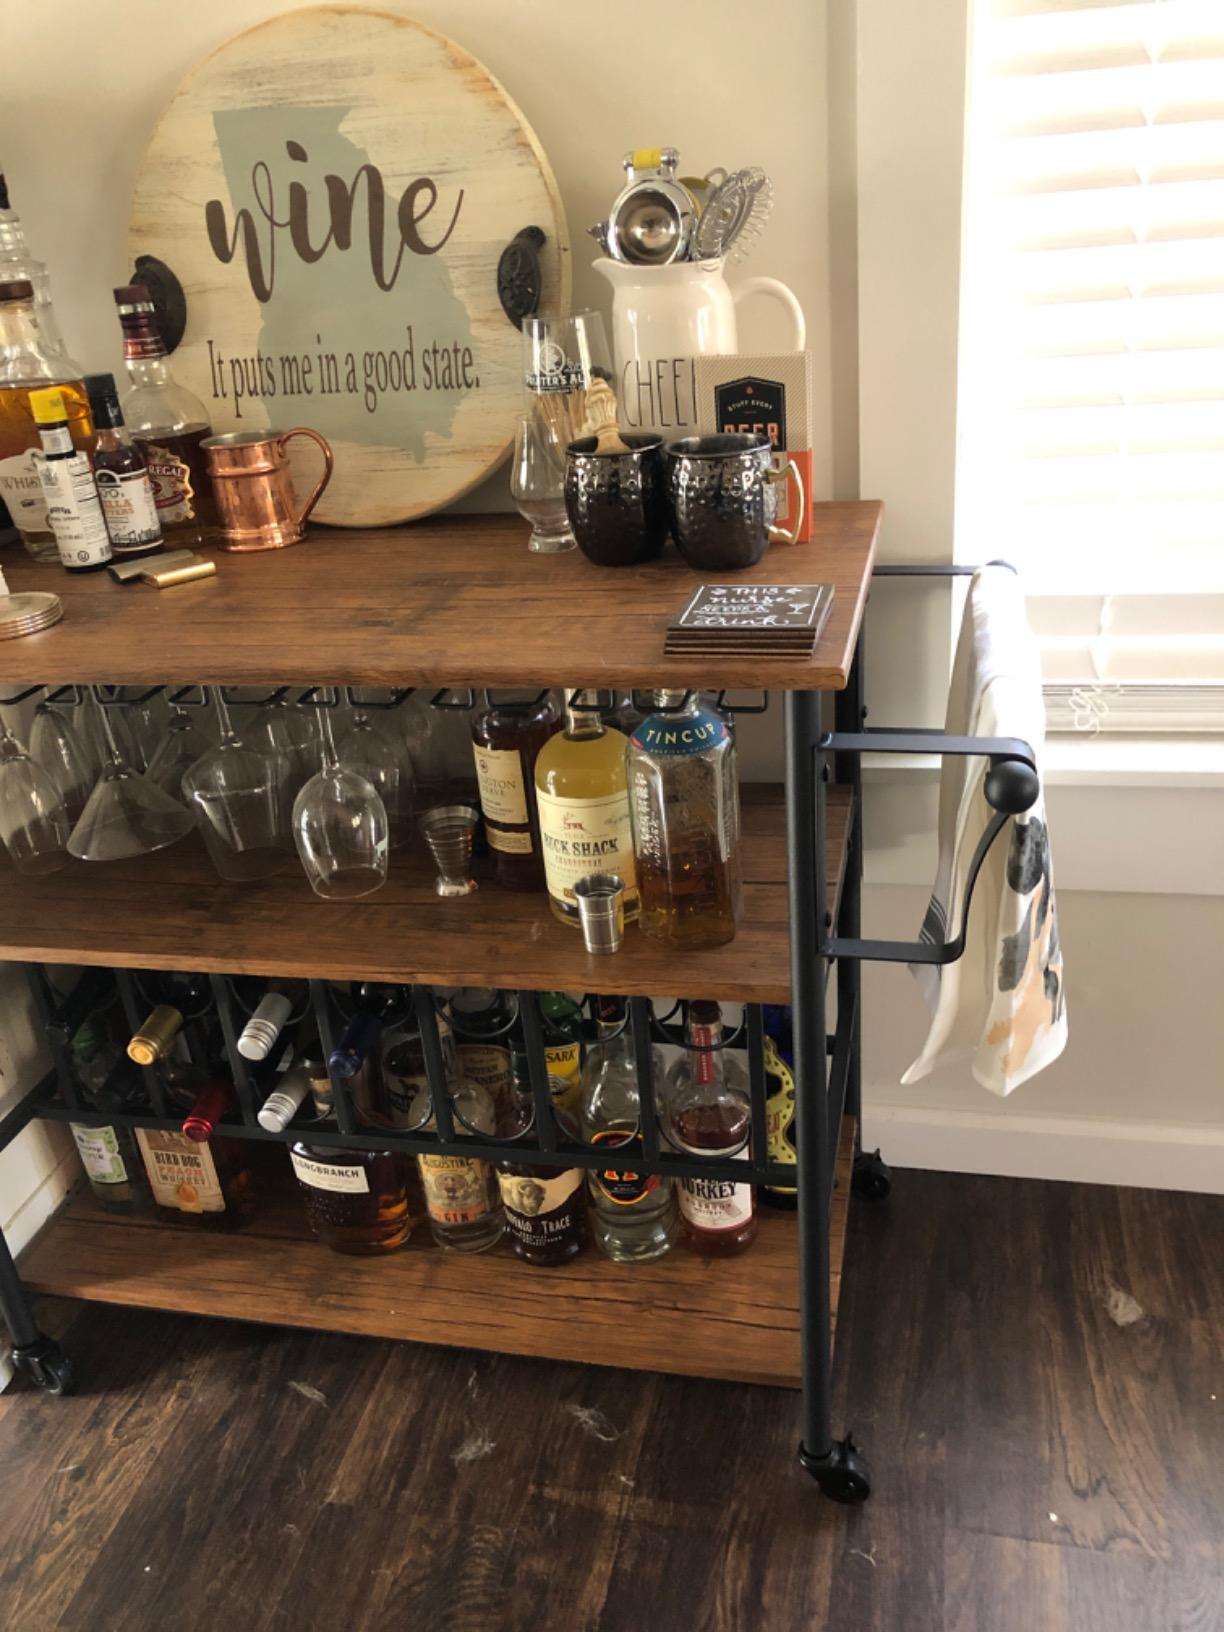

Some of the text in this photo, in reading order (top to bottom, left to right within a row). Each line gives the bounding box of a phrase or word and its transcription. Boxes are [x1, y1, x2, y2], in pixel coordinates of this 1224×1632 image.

[205, 140, 464, 303] wine
[206, 325, 480, 418] It puts me in a good state.
[622, 358, 698, 427] CHEE
[751, 400, 773, 411] EVERY
[646, 722, 716, 744] TINCUP
[572, 838, 619, 857] SHACK
[295, 1157, 359, 1178] LONGBRANCH
[541, 1215, 571, 1234] TRACE
